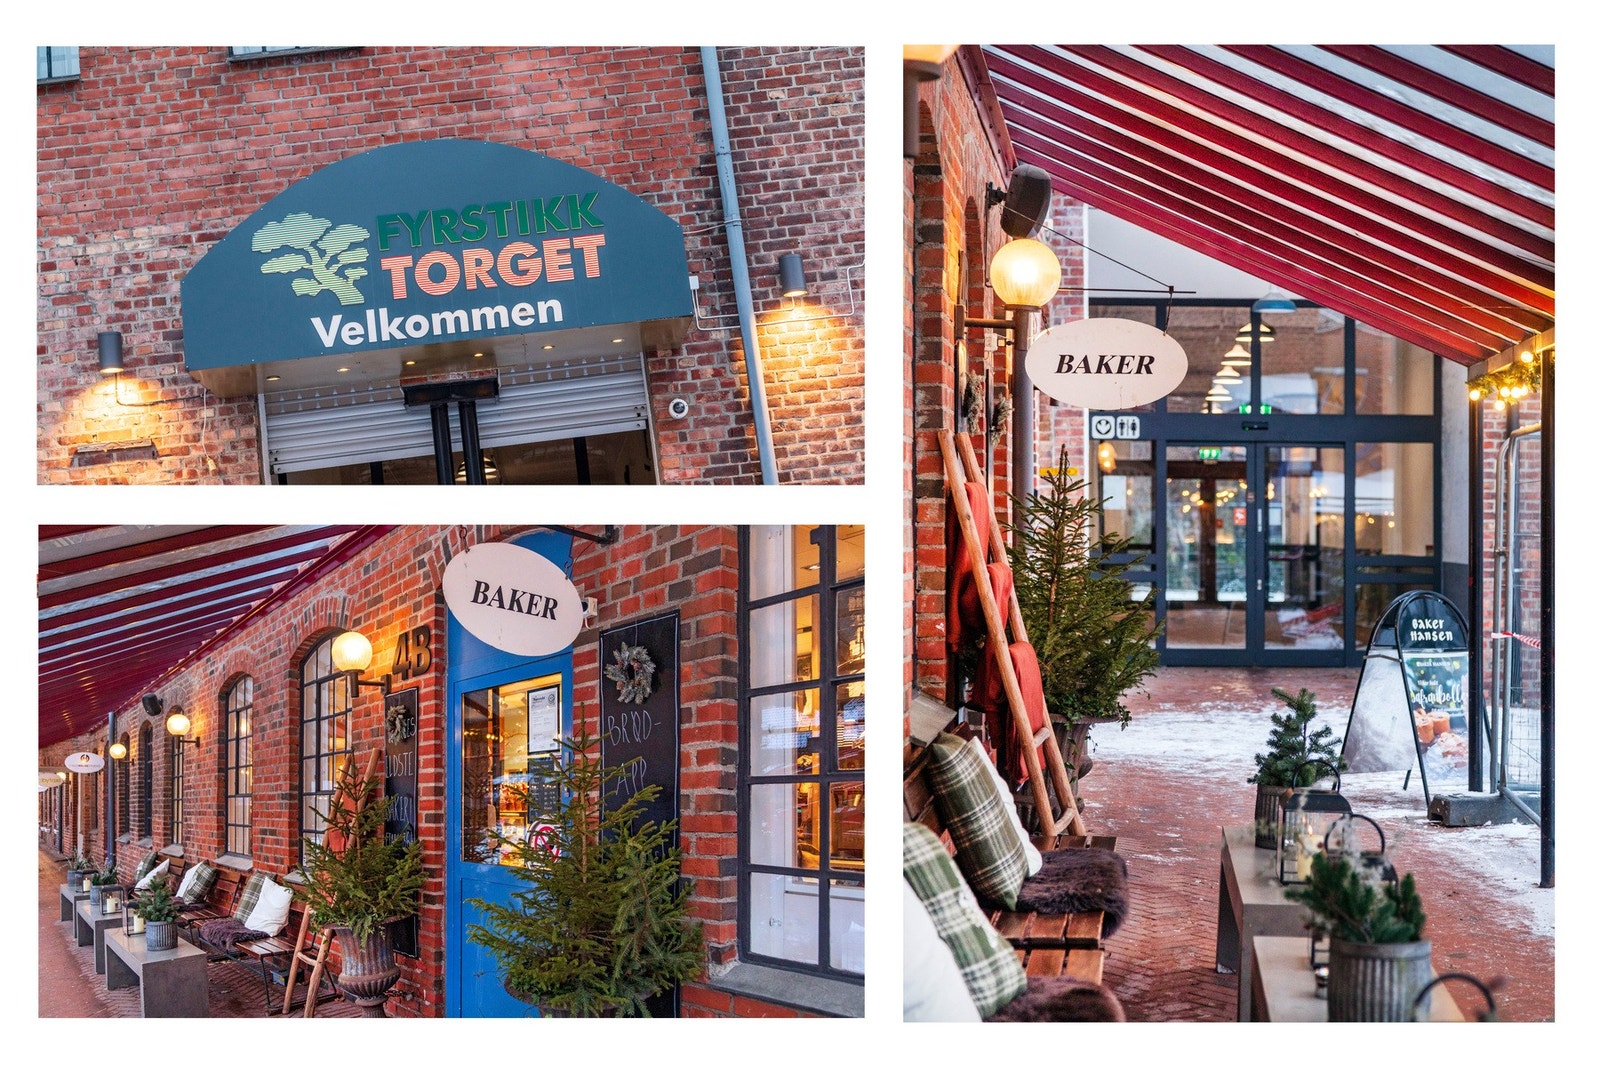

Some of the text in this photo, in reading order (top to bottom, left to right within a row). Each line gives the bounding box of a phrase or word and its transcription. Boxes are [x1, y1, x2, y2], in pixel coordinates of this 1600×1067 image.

[376, 191, 604, 251] FYRSTIKK
[380, 233, 606, 300] TORGET
[310, 299, 563, 348] Velkommen
[1054, 353, 1156, 375] BAKER
[470, 579, 559, 620] BAKER
[391, 624, 432, 681] 4B
